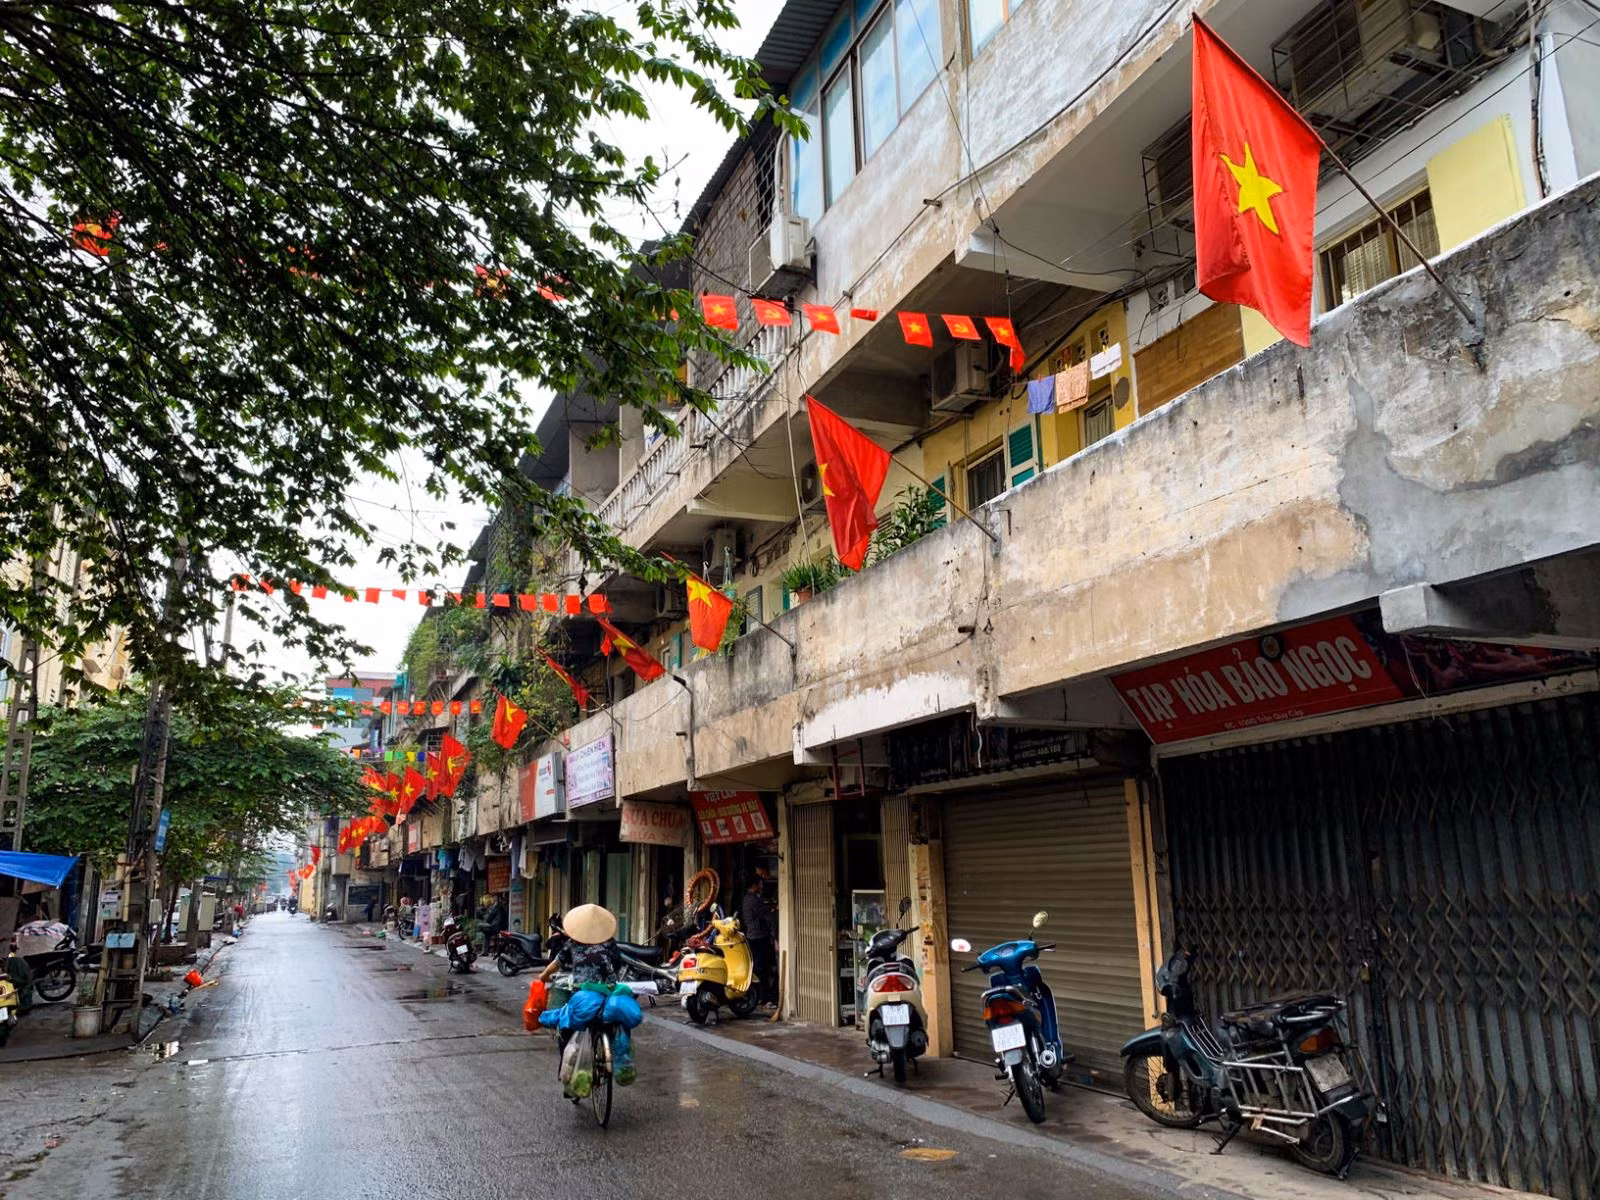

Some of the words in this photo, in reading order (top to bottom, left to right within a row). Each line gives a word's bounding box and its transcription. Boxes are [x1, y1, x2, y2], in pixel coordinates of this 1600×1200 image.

[1127, 683, 1178, 729] TẠP
[1170, 666, 1236, 715] HÓA
[1221, 647, 1288, 704] BẢO
[1280, 636, 1373, 692] NGỌC
